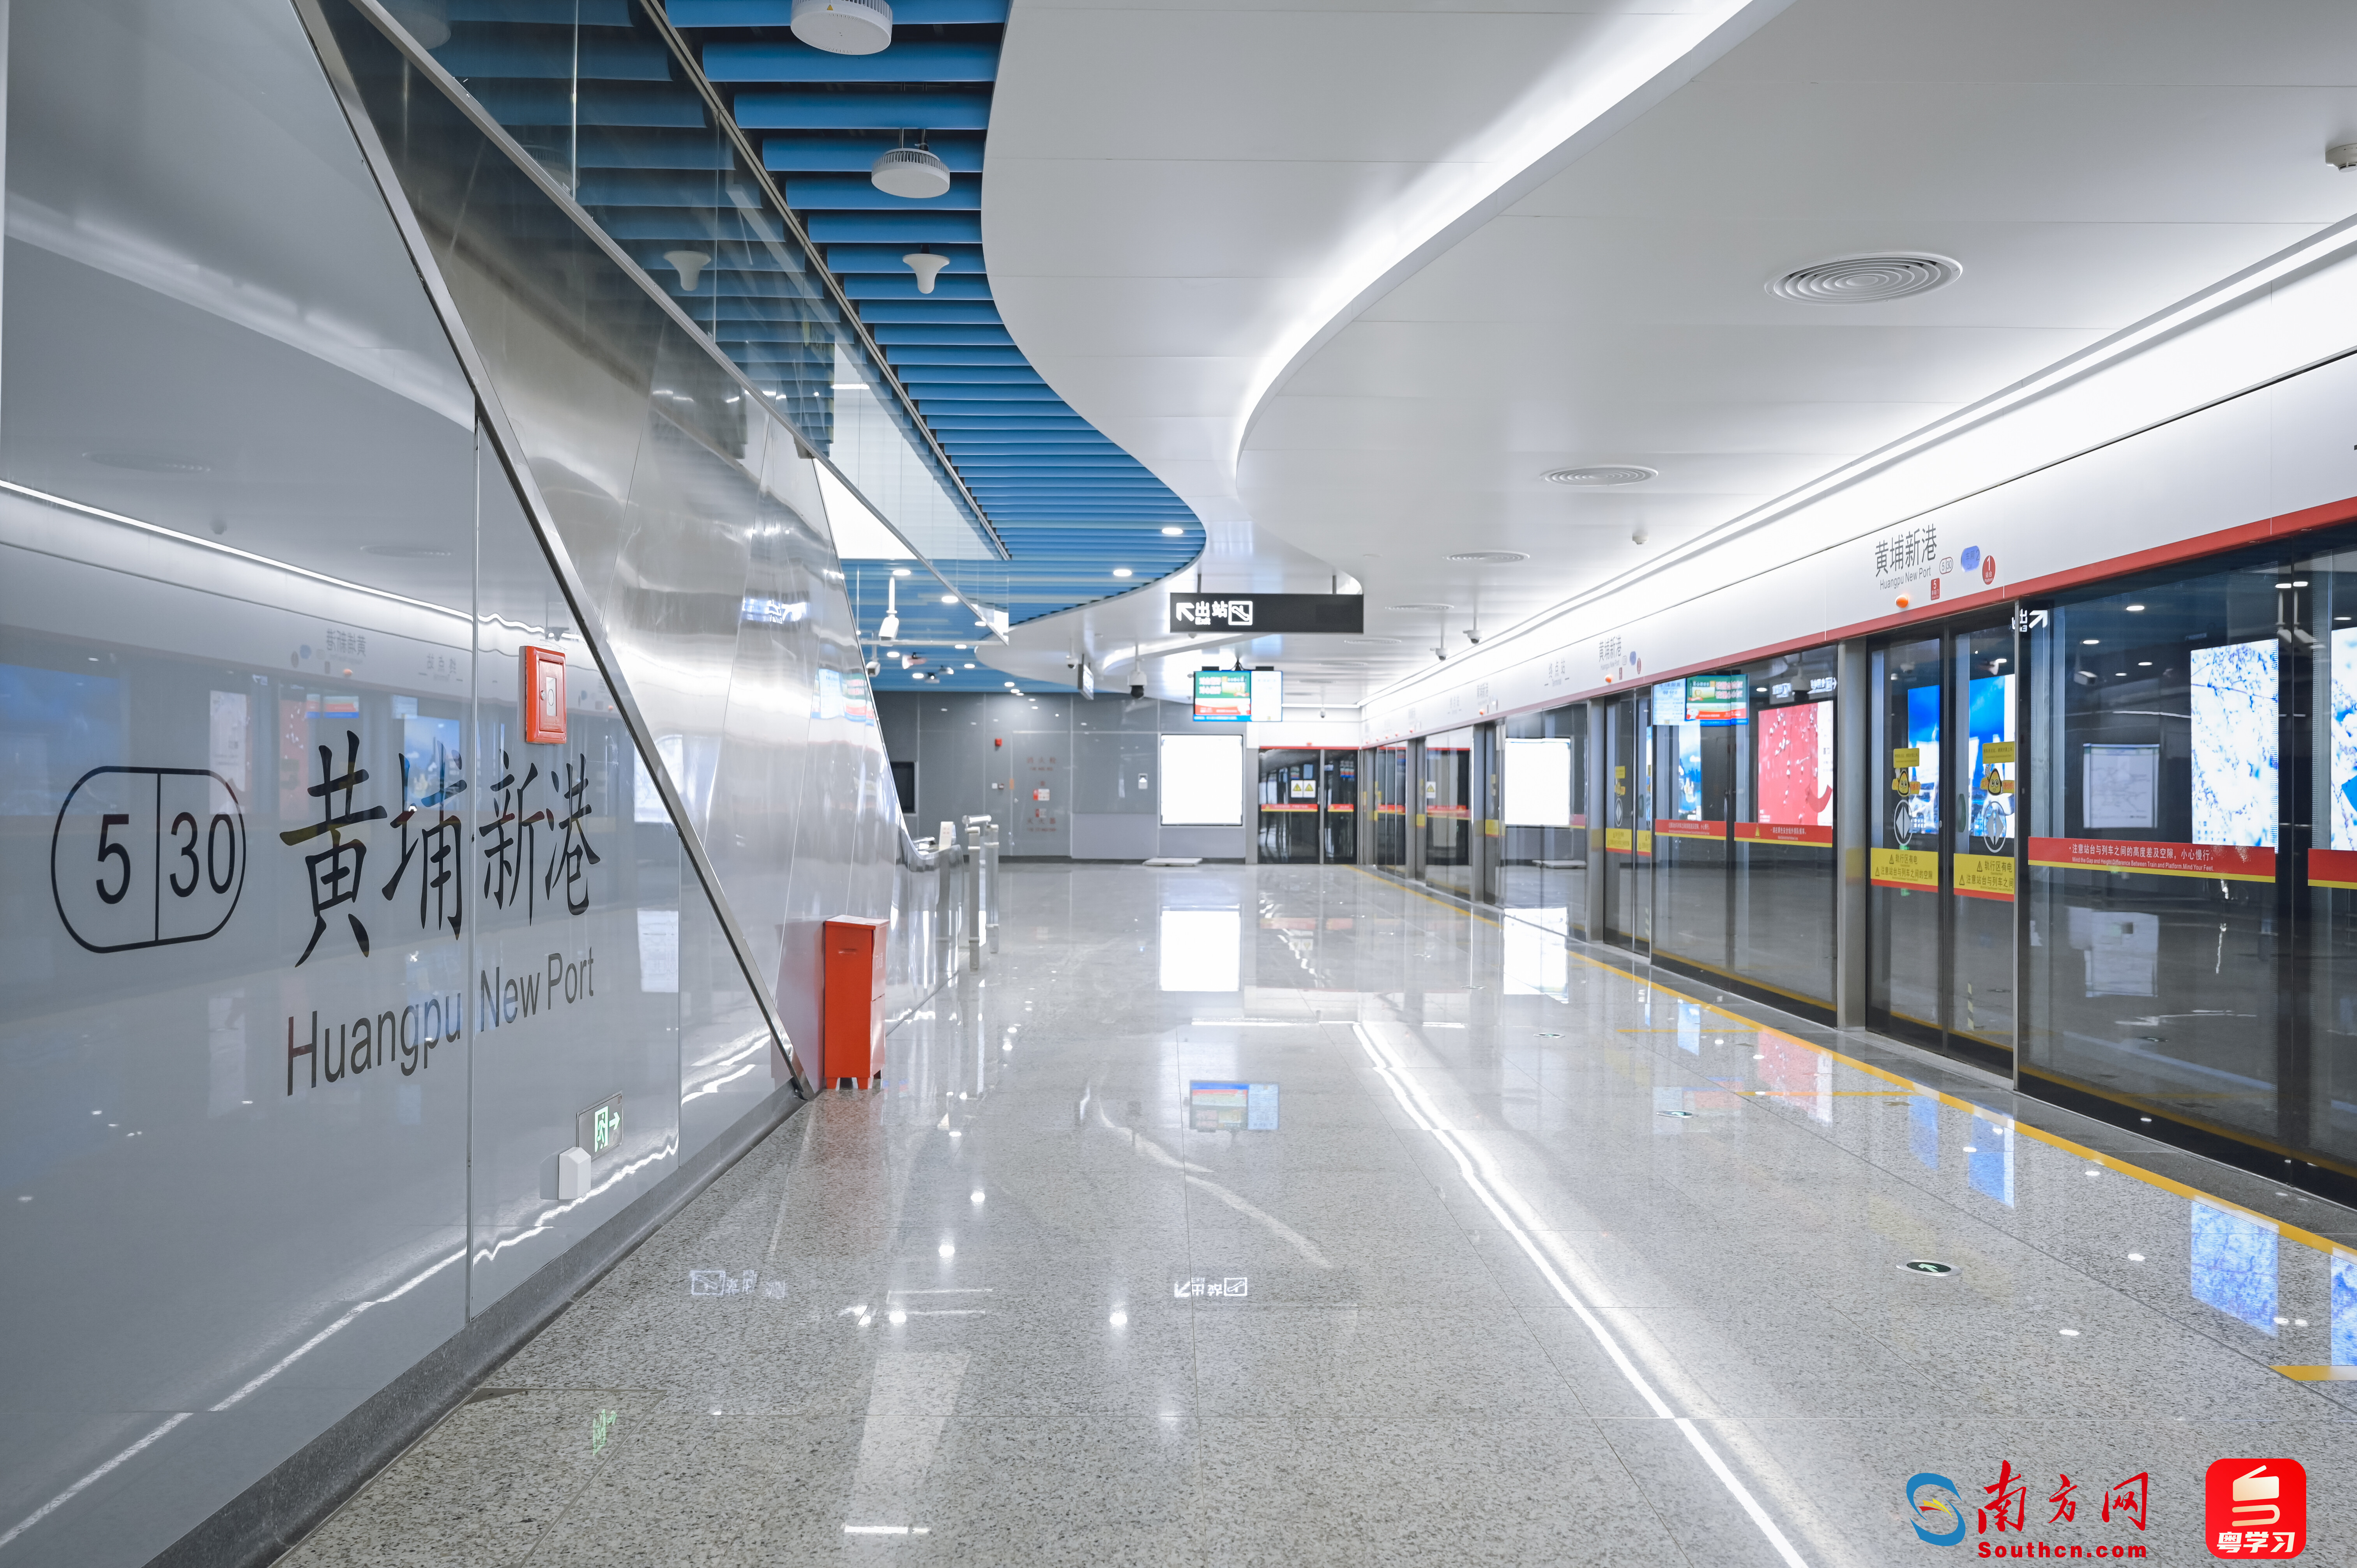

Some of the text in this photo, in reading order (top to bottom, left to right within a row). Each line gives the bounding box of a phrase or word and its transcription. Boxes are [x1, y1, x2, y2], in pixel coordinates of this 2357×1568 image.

[1875, 523, 1937, 578] 黄埔新港
[1942, 560, 1952, 571] 5 30
[1987, 556, 1990, 571] 1
[1880, 566, 1931, 590] Huangpu New Port
[1933, 580, 1936, 589] 5
[1195, 600, 1228, 618] 出站
[1599, 635, 1622, 663] 黄埔新港
[96, 812, 235, 904] 5 30
[279, 730, 601, 968] 黄埔新港
[1895, 854, 1918, 865] 轨行区有电
[1984, 860, 2012, 873] 轨行区有电
[287, 946, 594, 1096] Huangpu New Port
